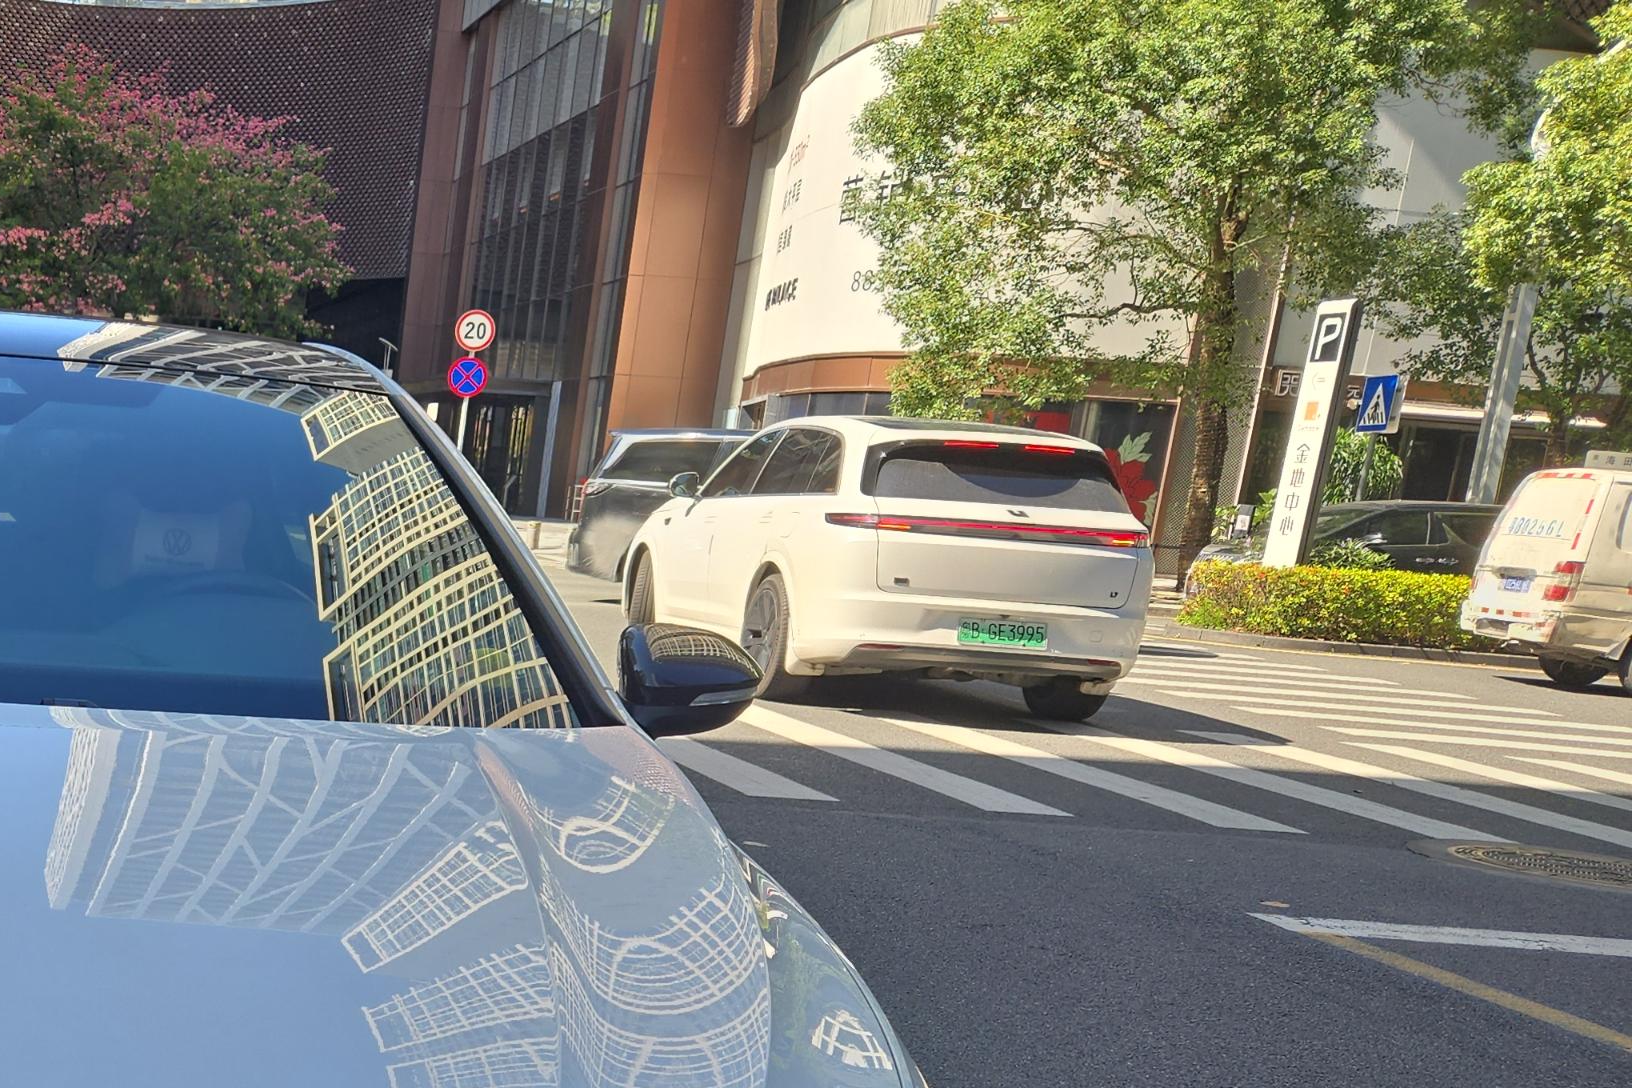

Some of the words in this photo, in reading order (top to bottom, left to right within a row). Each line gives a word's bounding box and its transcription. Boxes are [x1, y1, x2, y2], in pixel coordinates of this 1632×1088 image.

[463, 321, 487, 340] 20
[1314, 316, 1343, 360] P
[1279, 443, 1311, 536] 金地中心
